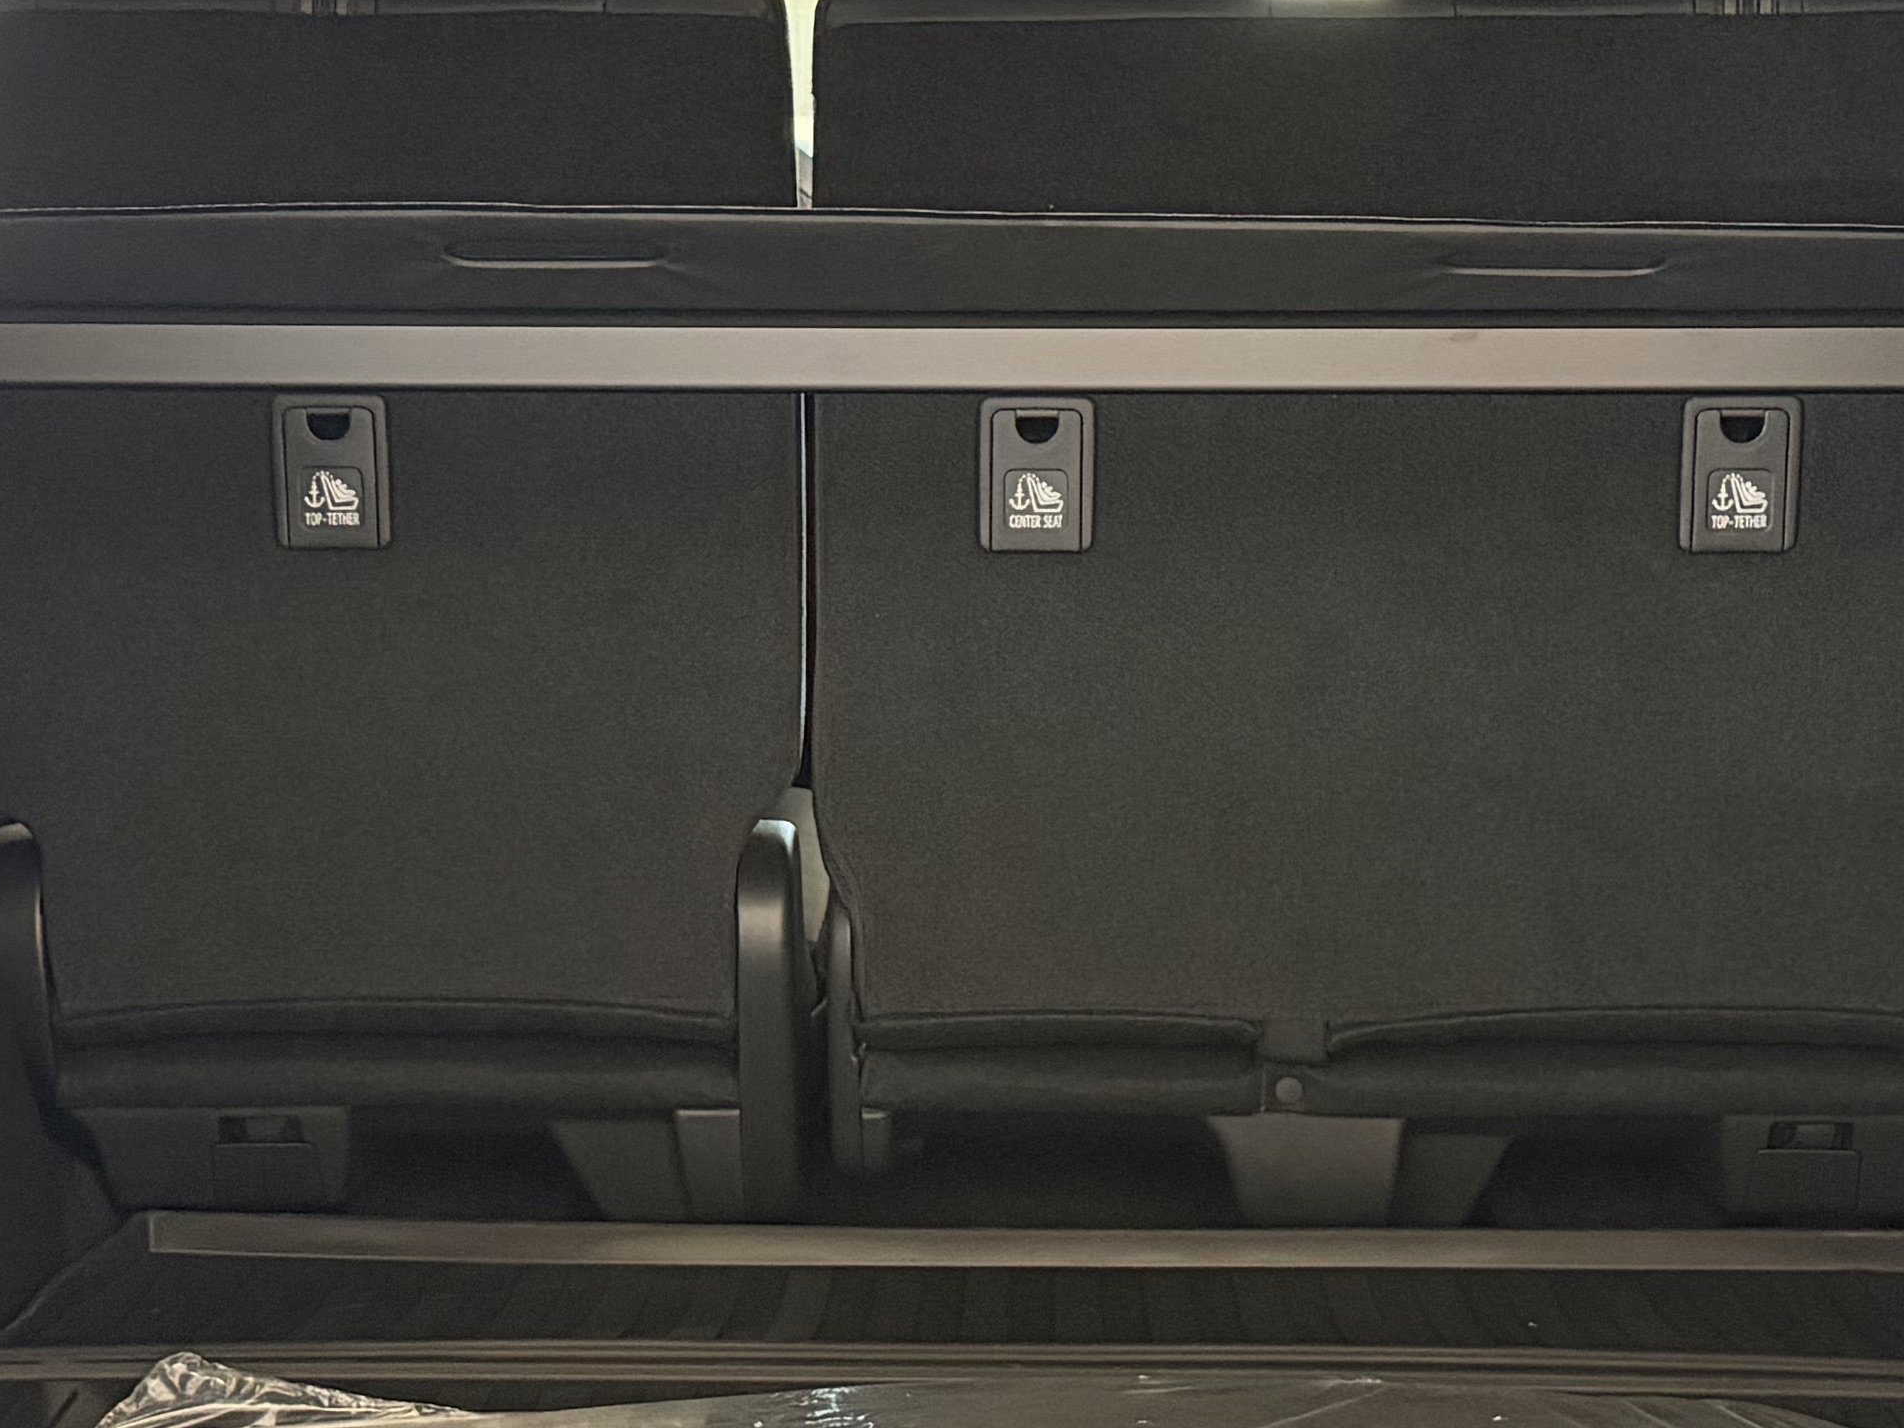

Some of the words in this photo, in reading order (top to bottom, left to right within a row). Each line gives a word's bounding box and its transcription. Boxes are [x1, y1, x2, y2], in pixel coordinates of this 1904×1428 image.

[305, 512, 360, 525] TOP-TETHER
[1009, 515, 1041, 528] CENTER
[1043, 515, 1064, 528] SEAT
[1711, 515, 1767, 529] TOP-TETHER
